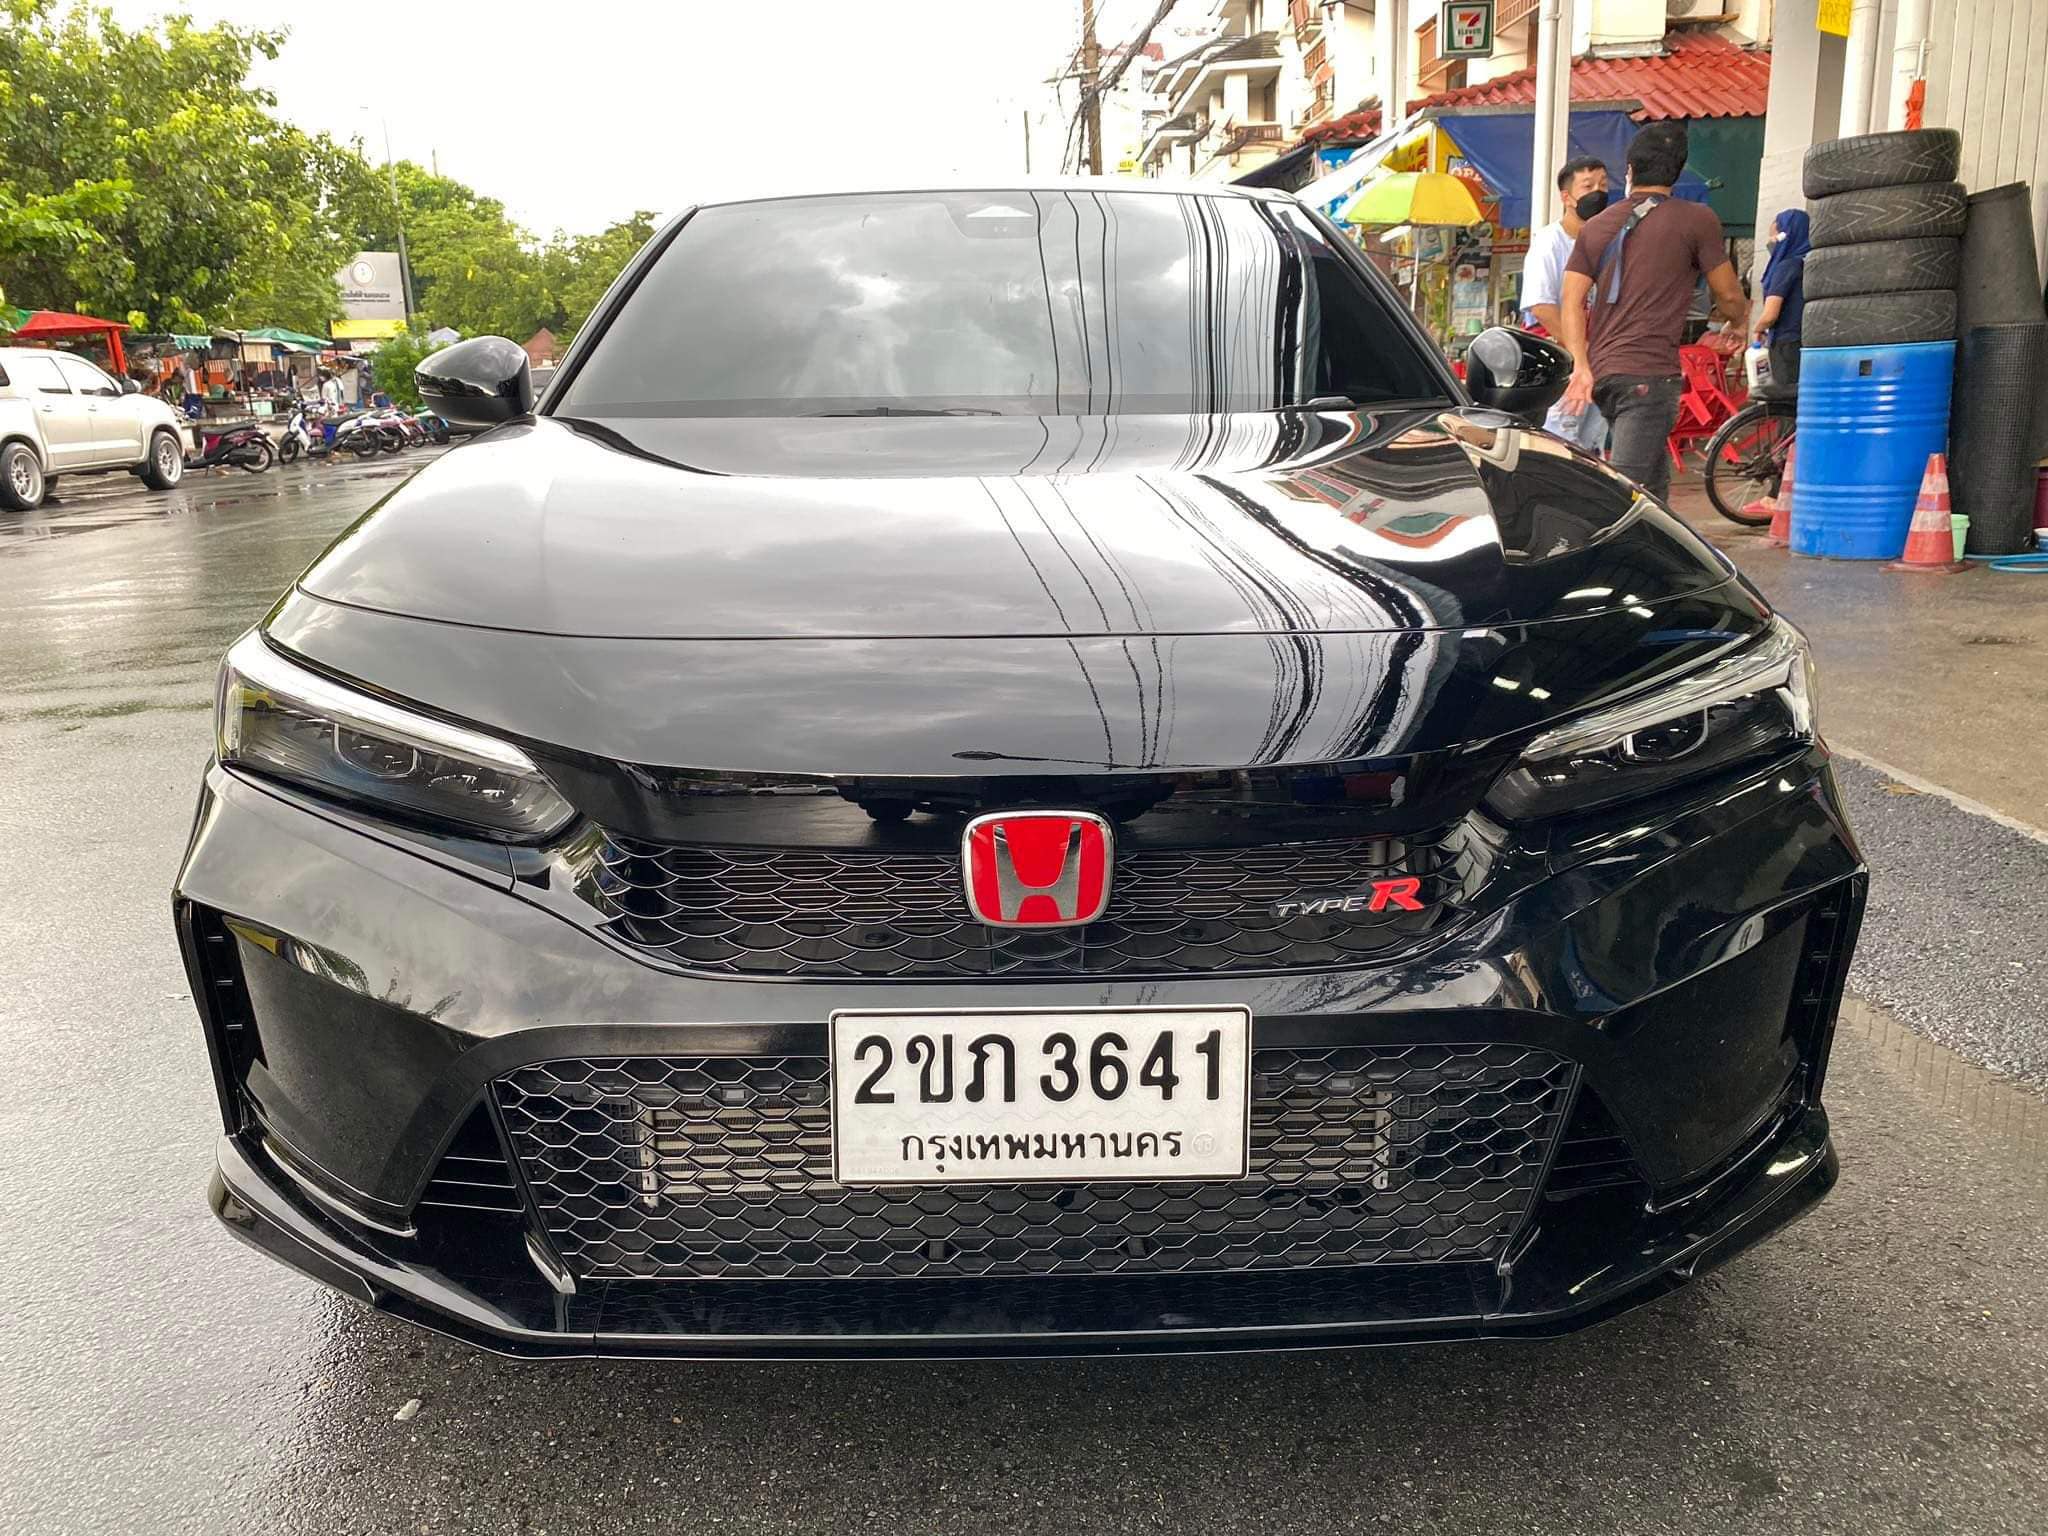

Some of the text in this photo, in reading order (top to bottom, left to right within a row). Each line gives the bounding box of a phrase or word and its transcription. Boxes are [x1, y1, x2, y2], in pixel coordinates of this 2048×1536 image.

[1275, 877, 1424, 918] TYPE R
[854, 1030, 1221, 1104] 2ขภ 3641
[901, 1131, 1182, 1173] กรุงเทพมหานคร
